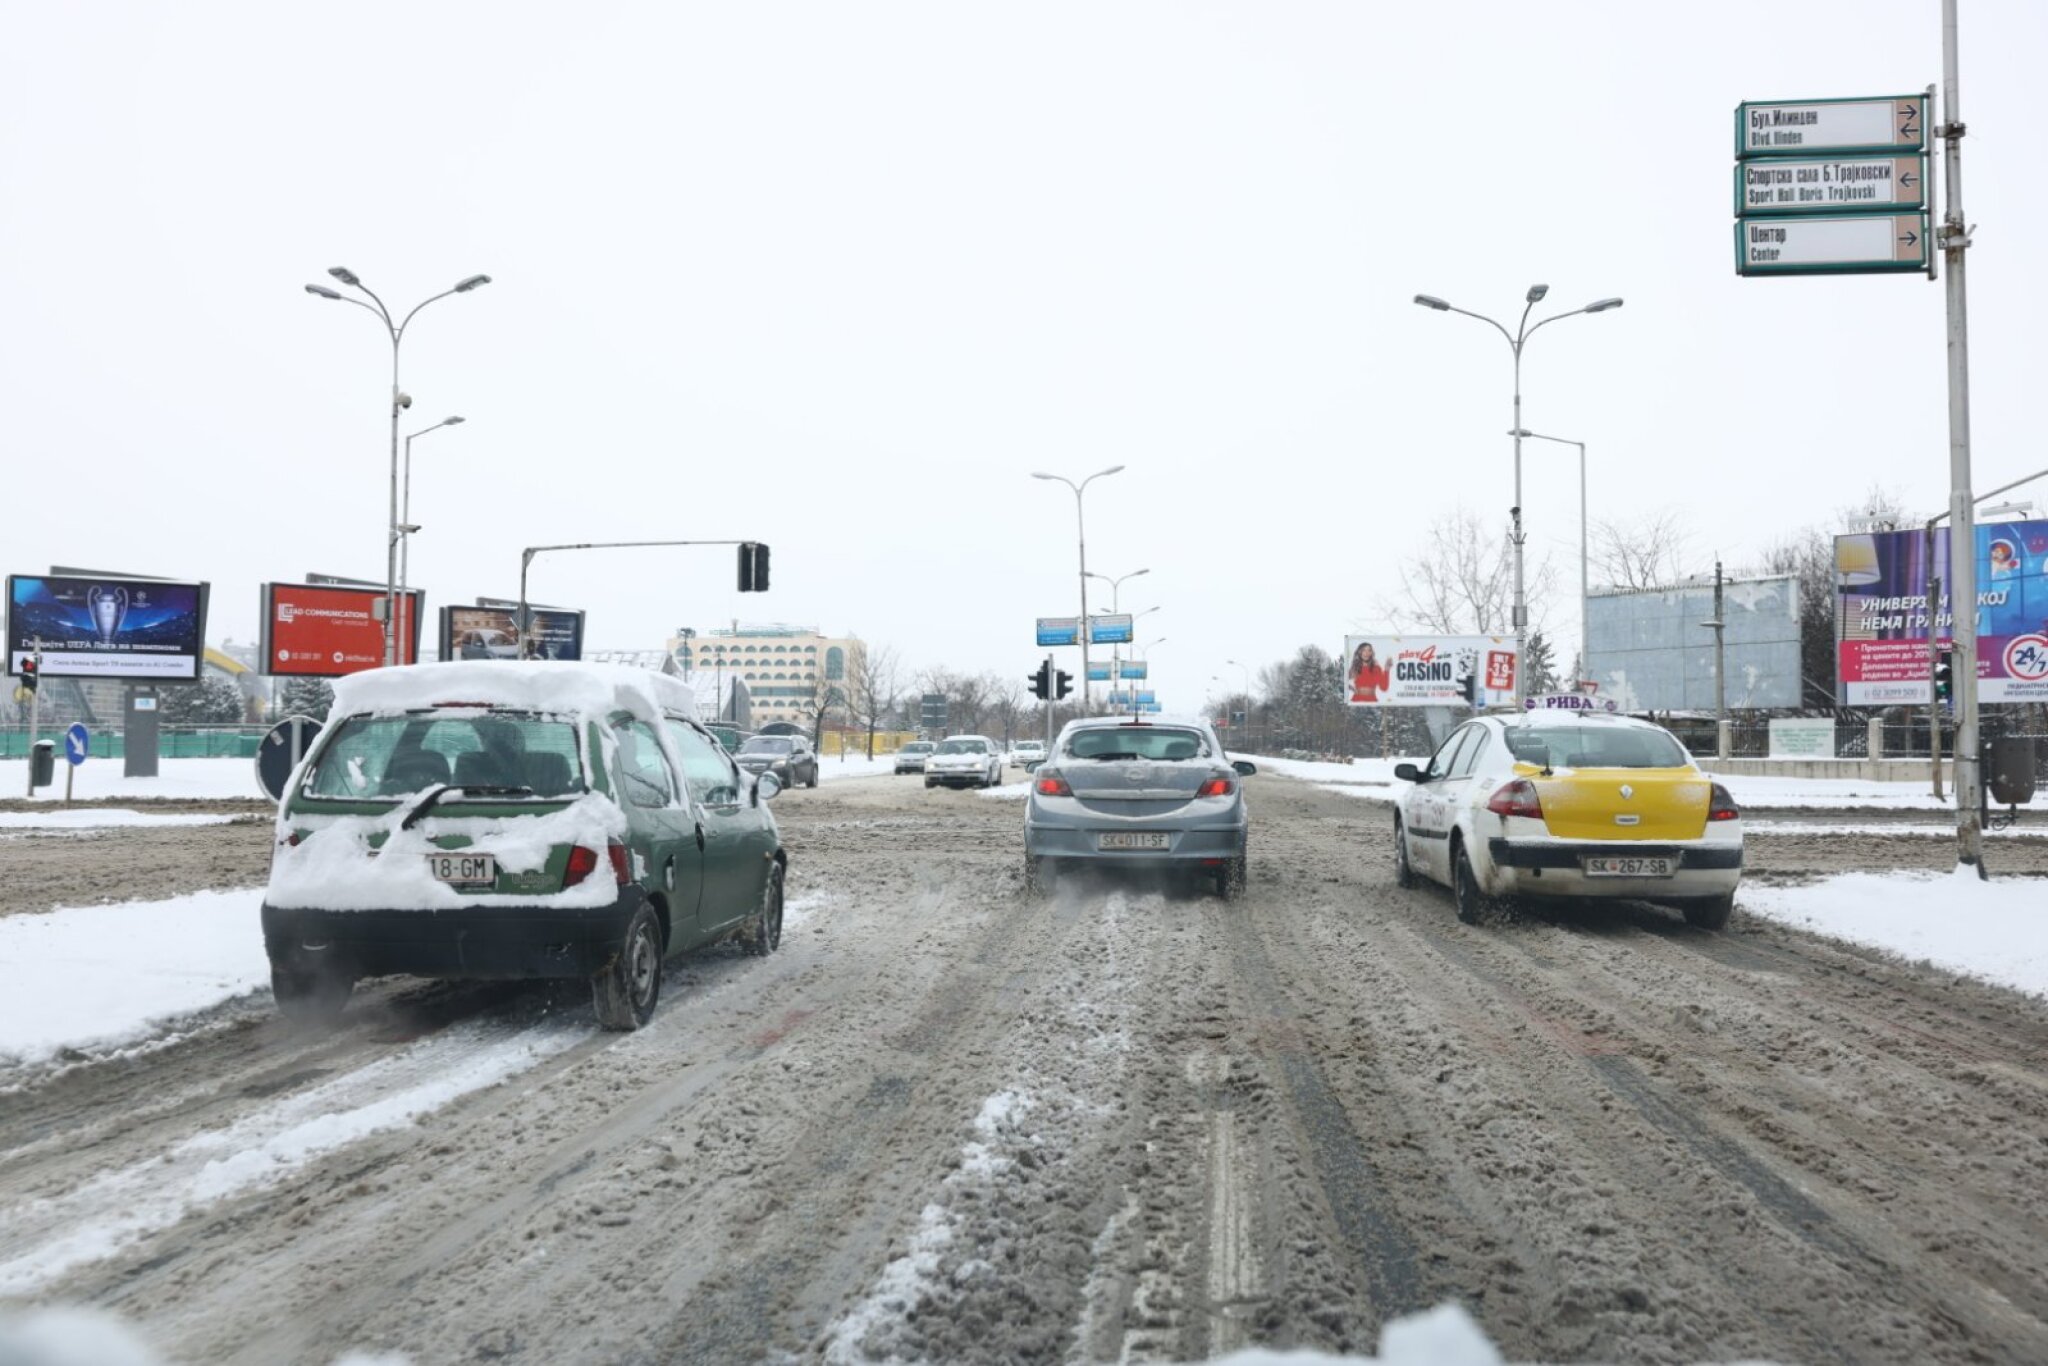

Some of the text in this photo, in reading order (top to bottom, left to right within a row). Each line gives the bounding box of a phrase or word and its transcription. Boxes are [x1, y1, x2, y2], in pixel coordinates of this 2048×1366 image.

[1746, 167, 1792, 187] Спортска
[1797, 168, 1819, 183] сала
[1749, 188, 1774, 204] Sport
[1799, 187, 1823, 201] Boris
[1827, 183, 1876, 201] Trajkovski
[1750, 226, 1786, 244] Центар
[1750, 247, 1780, 261] Center
[1860, 590, 2007, 611] УНИВЕРЗМ КОЈ
[305, 609, 369, 619] COMMUNICATIONS
[1860, 615, 1903, 631] НЕМА
[67, 640, 91, 649] UEFA
[1590, 859, 1609, 873] SK
